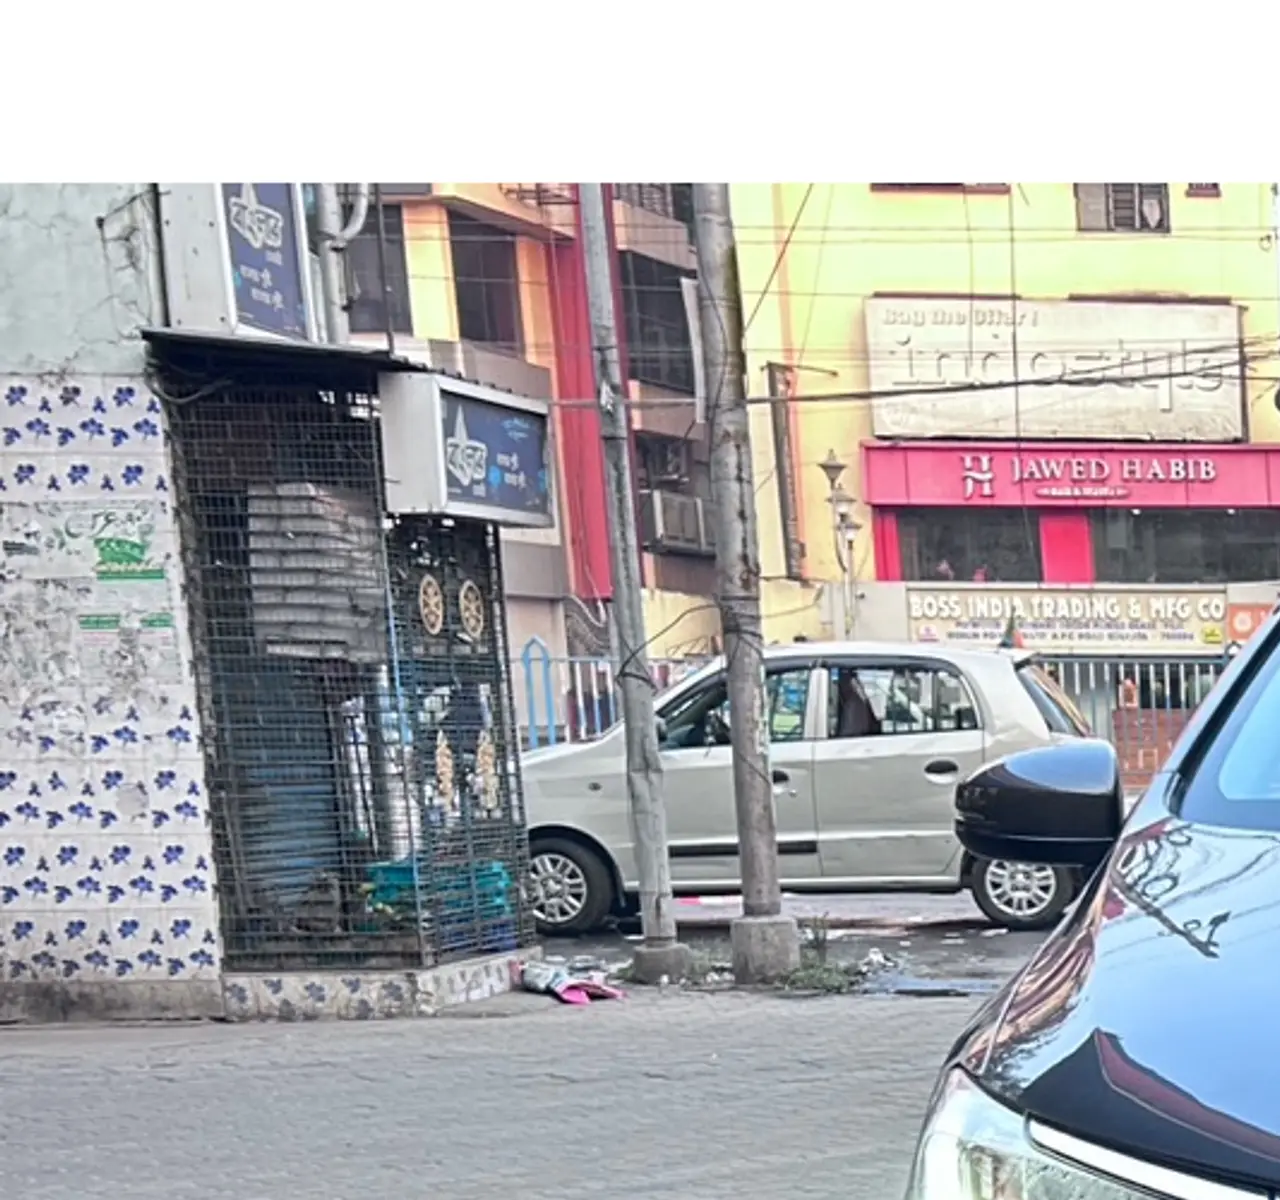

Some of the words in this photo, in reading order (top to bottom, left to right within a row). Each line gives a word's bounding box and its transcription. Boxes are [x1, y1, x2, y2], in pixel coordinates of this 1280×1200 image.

[1011, 457, 1110, 484] JAWED
[1121, 458, 1217, 482] HABIB
[909, 594, 962, 619] BOSS
[966, 595, 1025, 619] INDIA
[1030, 596, 1121, 619] TRADING
[1149, 598, 1193, 619] MFG
[1196, 598, 1225, 619] CO
